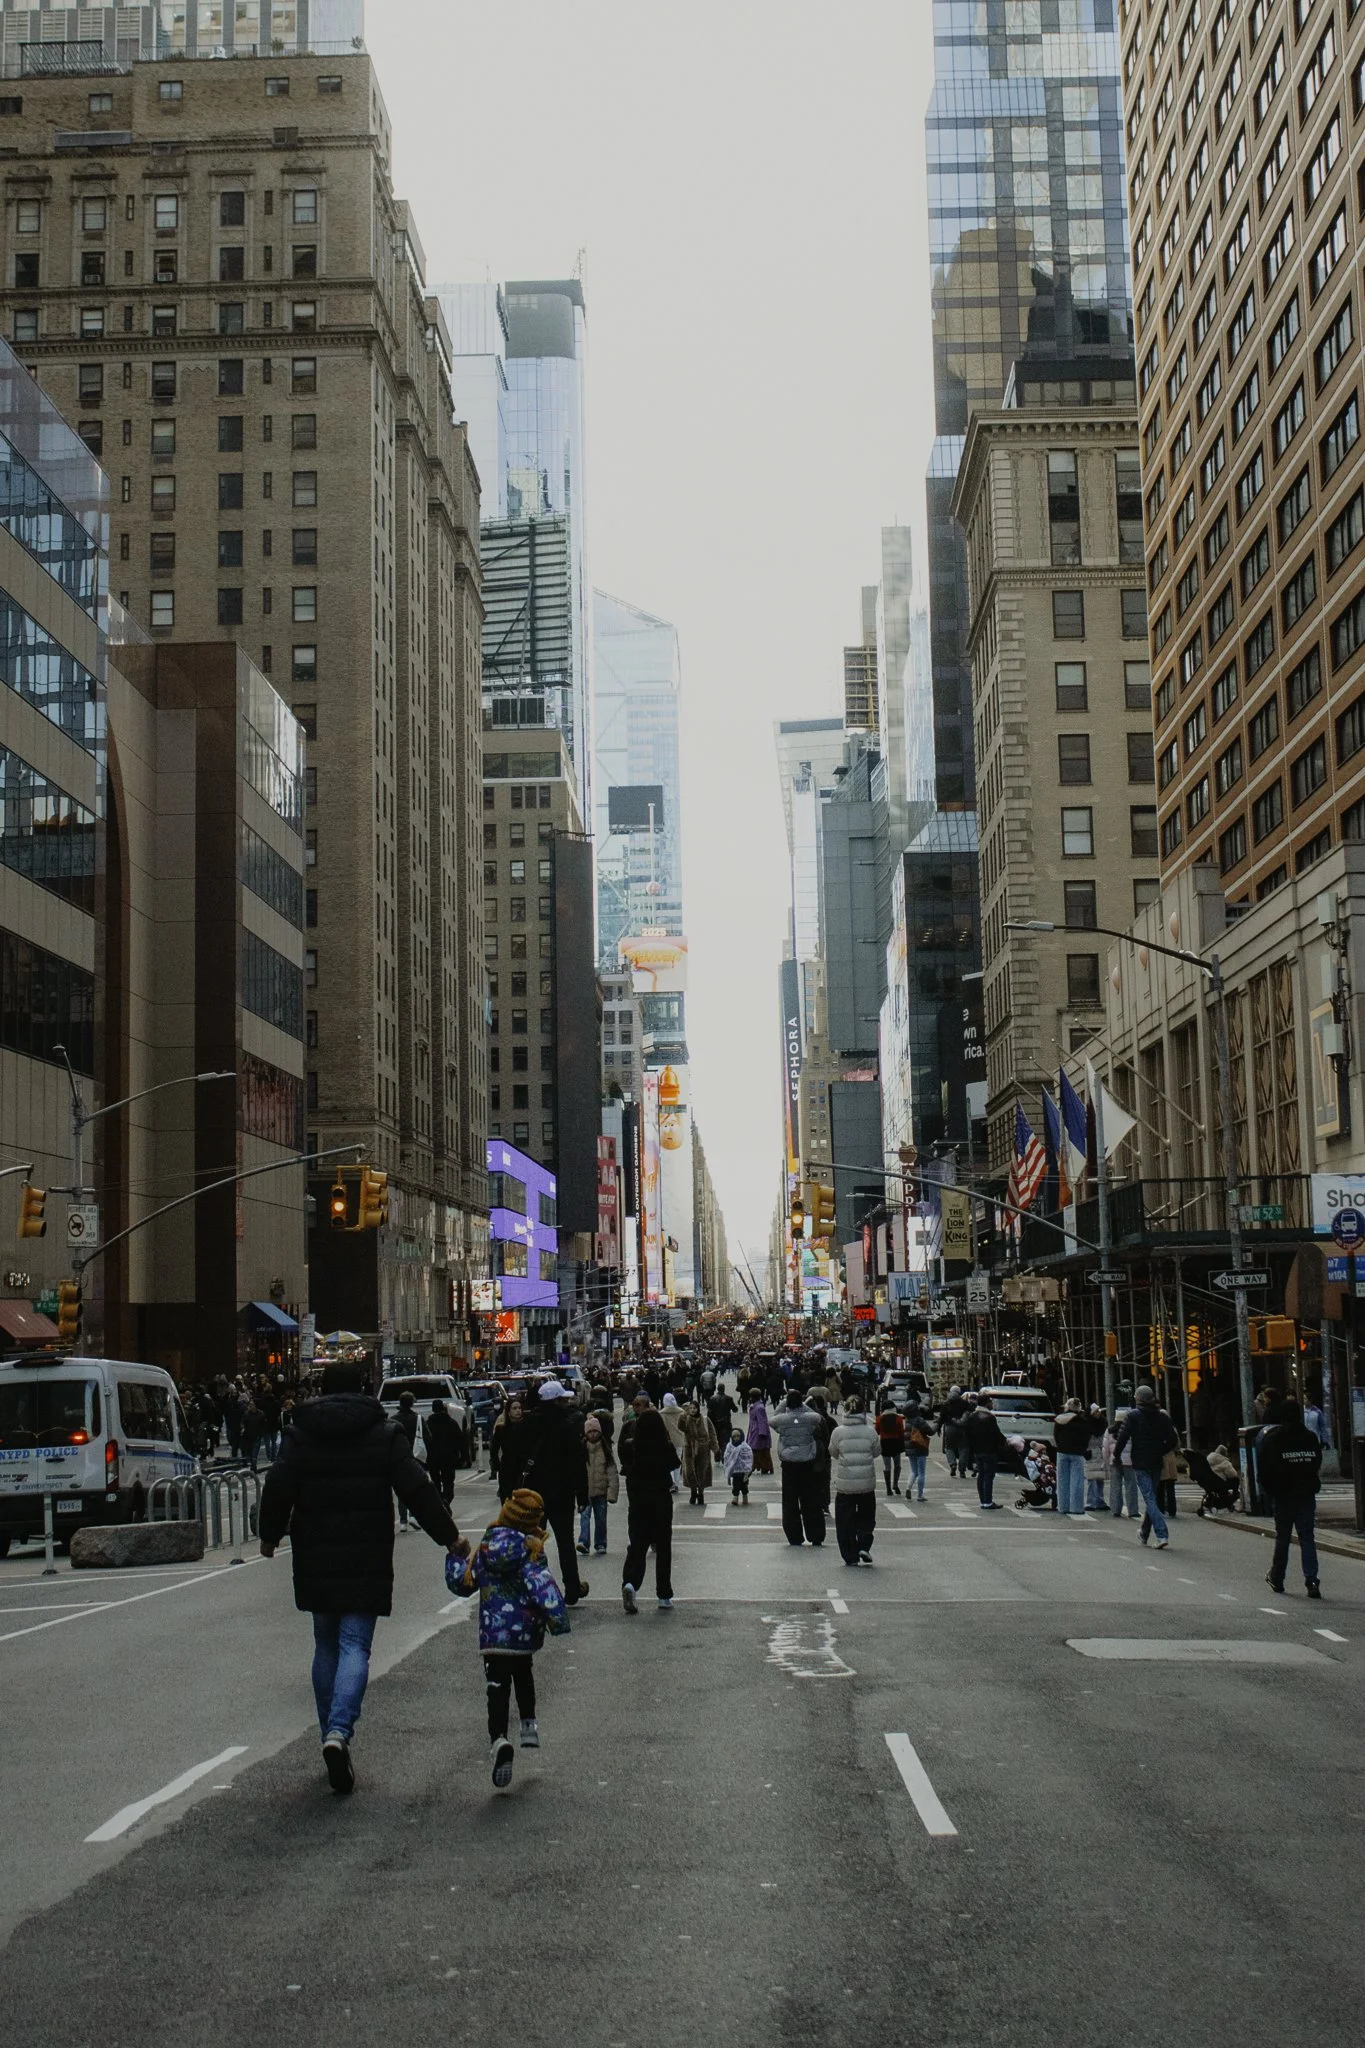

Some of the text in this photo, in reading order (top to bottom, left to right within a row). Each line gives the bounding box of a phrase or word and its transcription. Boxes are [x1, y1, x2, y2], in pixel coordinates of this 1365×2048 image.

[641, 927, 667, 937] 2025
[787, 1016, 801, 1101] SEPHORA
[948, 1208, 963, 1216] THE
[1263, 1207, 1274, 1220] 52
[946, 1218, 965, 1229] LION
[945, 1231, 968, 1243] KING
[1220, 1275, 1263, 1285] ONE WAY
[969, 1291, 987, 1302] 25
[0, 1447, 79, 1459] NYPD POLICE
